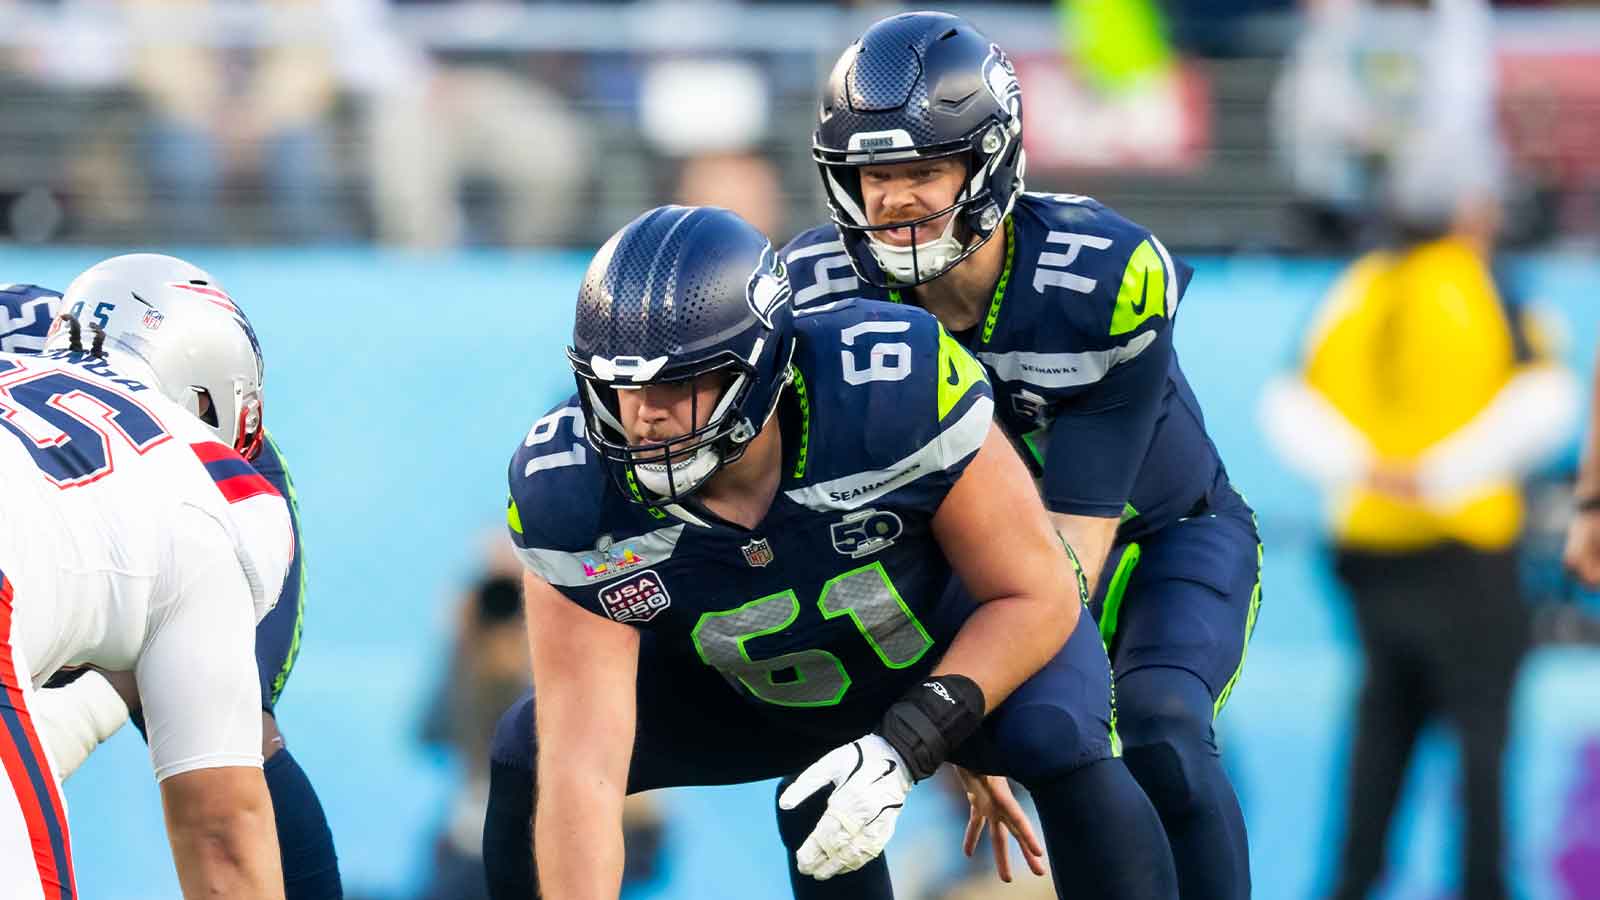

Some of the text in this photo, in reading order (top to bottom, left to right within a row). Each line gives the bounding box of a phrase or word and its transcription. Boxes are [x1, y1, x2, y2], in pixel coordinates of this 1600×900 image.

[1032, 231, 1113, 294] 14
[841, 321, 912, 385] 61
[1020, 363, 1079, 375] SEAHAWKS
[524, 406, 587, 478] 61
[829, 509, 904, 555] 50
[605, 578, 655, 605] USA
[613, 593, 667, 621] 250
[690, 560, 935, 707] 61
